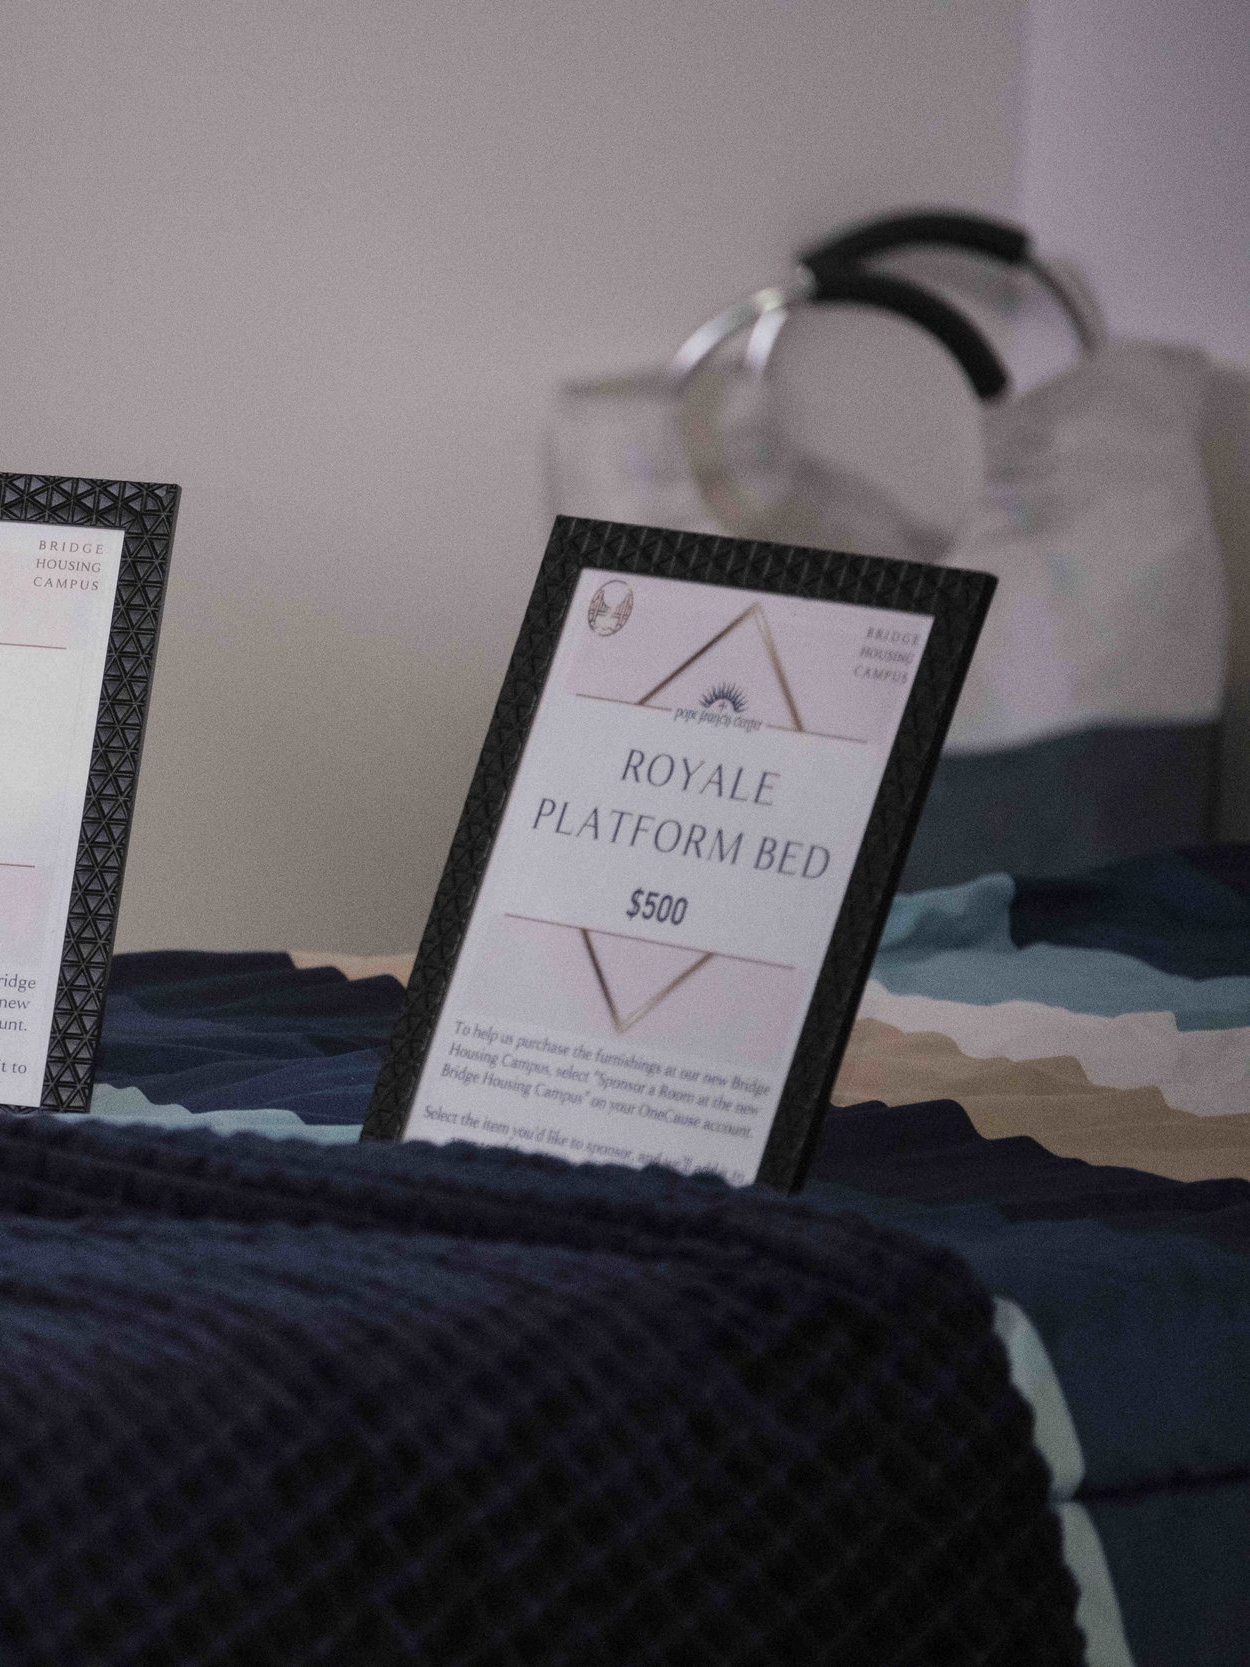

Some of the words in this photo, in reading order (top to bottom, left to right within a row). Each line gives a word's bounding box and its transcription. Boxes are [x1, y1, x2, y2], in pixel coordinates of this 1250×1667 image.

[38, 539, 104, 555] BRIDGE
[35, 558, 101, 573] HOUSING
[32, 576, 99, 591] CAMPUS
[864, 626, 921, 646] BRIDGE
[858, 645, 915, 666] HOUSING
[851, 664, 910, 685] CAMPUS
[618, 747, 782, 807] ROYALE
[530, 796, 746, 866] PLATFORM
[752, 835, 833, 881] BED
[624, 886, 691, 928] $500
[11, 1062, 28, 1075] to
[471, 1024, 498, 1045] help
[514, 1034, 571, 1058] purchase
[572, 1044, 594, 1060] the
[593, 1048, 663, 1076] furnishings
[678, 1069, 700, 1082] our
[702, 1073, 729, 1087] new
[729, 1074, 772, 1098] Bridge
[448, 1042, 501, 1068] Housing
[500, 1052, 554, 1078] Campus,
[554, 1064, 590, 1083] select
[592, 1070, 648, 1096] “Sponsor
[658, 1084, 696, 1104] Room
[710, 1094, 734, 1112] the
[734, 1102, 760, 1116] new
[439, 1062, 482, 1087] Bridge
[480, 1071, 534, 1098] Housing
[533, 1082, 590, 1108] Campus”
[608, 1101, 636, 1116] your
[637, 1102, 702, 1128] OneCause
[702, 1117, 754, 1139] account.
[422, 1104, 459, 1125] Select
[458, 1111, 481, 1129] the
[481, 1116, 510, 1135] item
[509, 1122, 546, 1146] you’d
[545, 1129, 570, 1147] like
